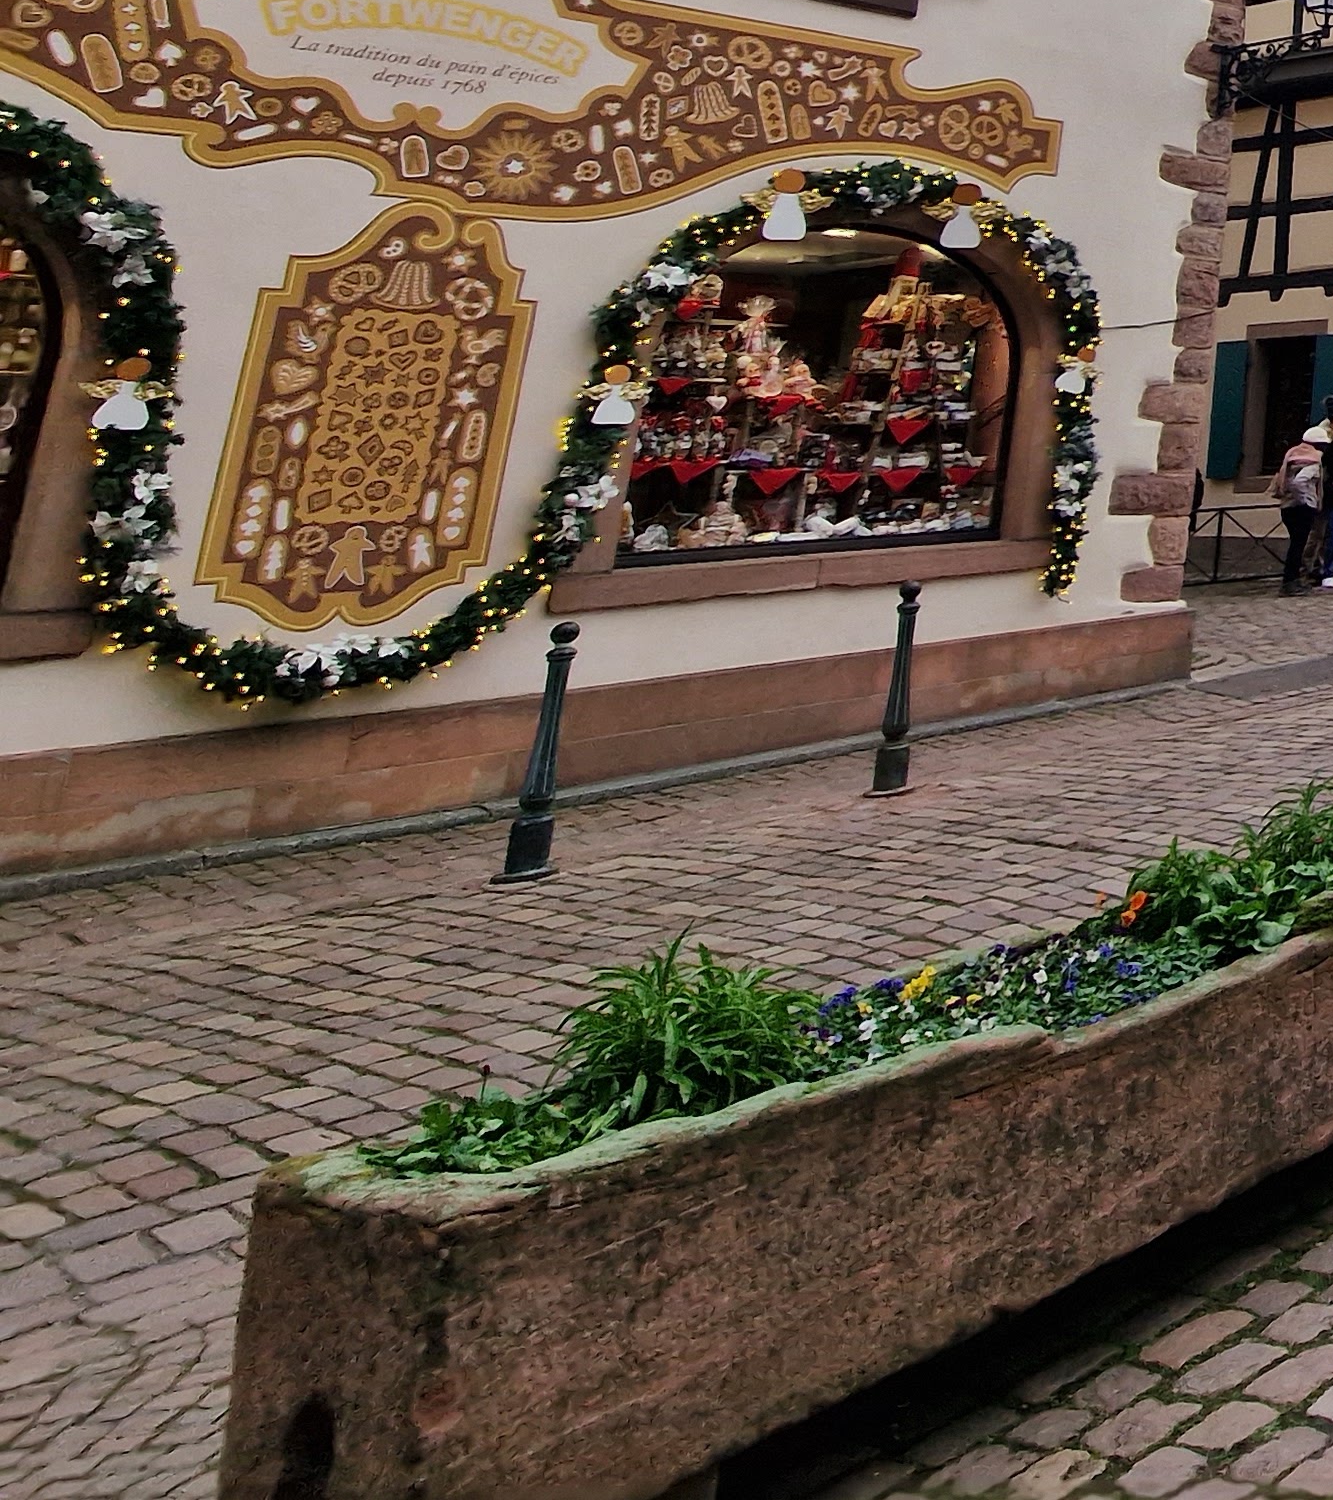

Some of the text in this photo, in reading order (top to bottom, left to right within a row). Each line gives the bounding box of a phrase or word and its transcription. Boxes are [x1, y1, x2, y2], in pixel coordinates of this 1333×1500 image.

[290, 34, 560, 85] La tradition du pain d'épices
[372, 67, 487, 95] depuis 1768
